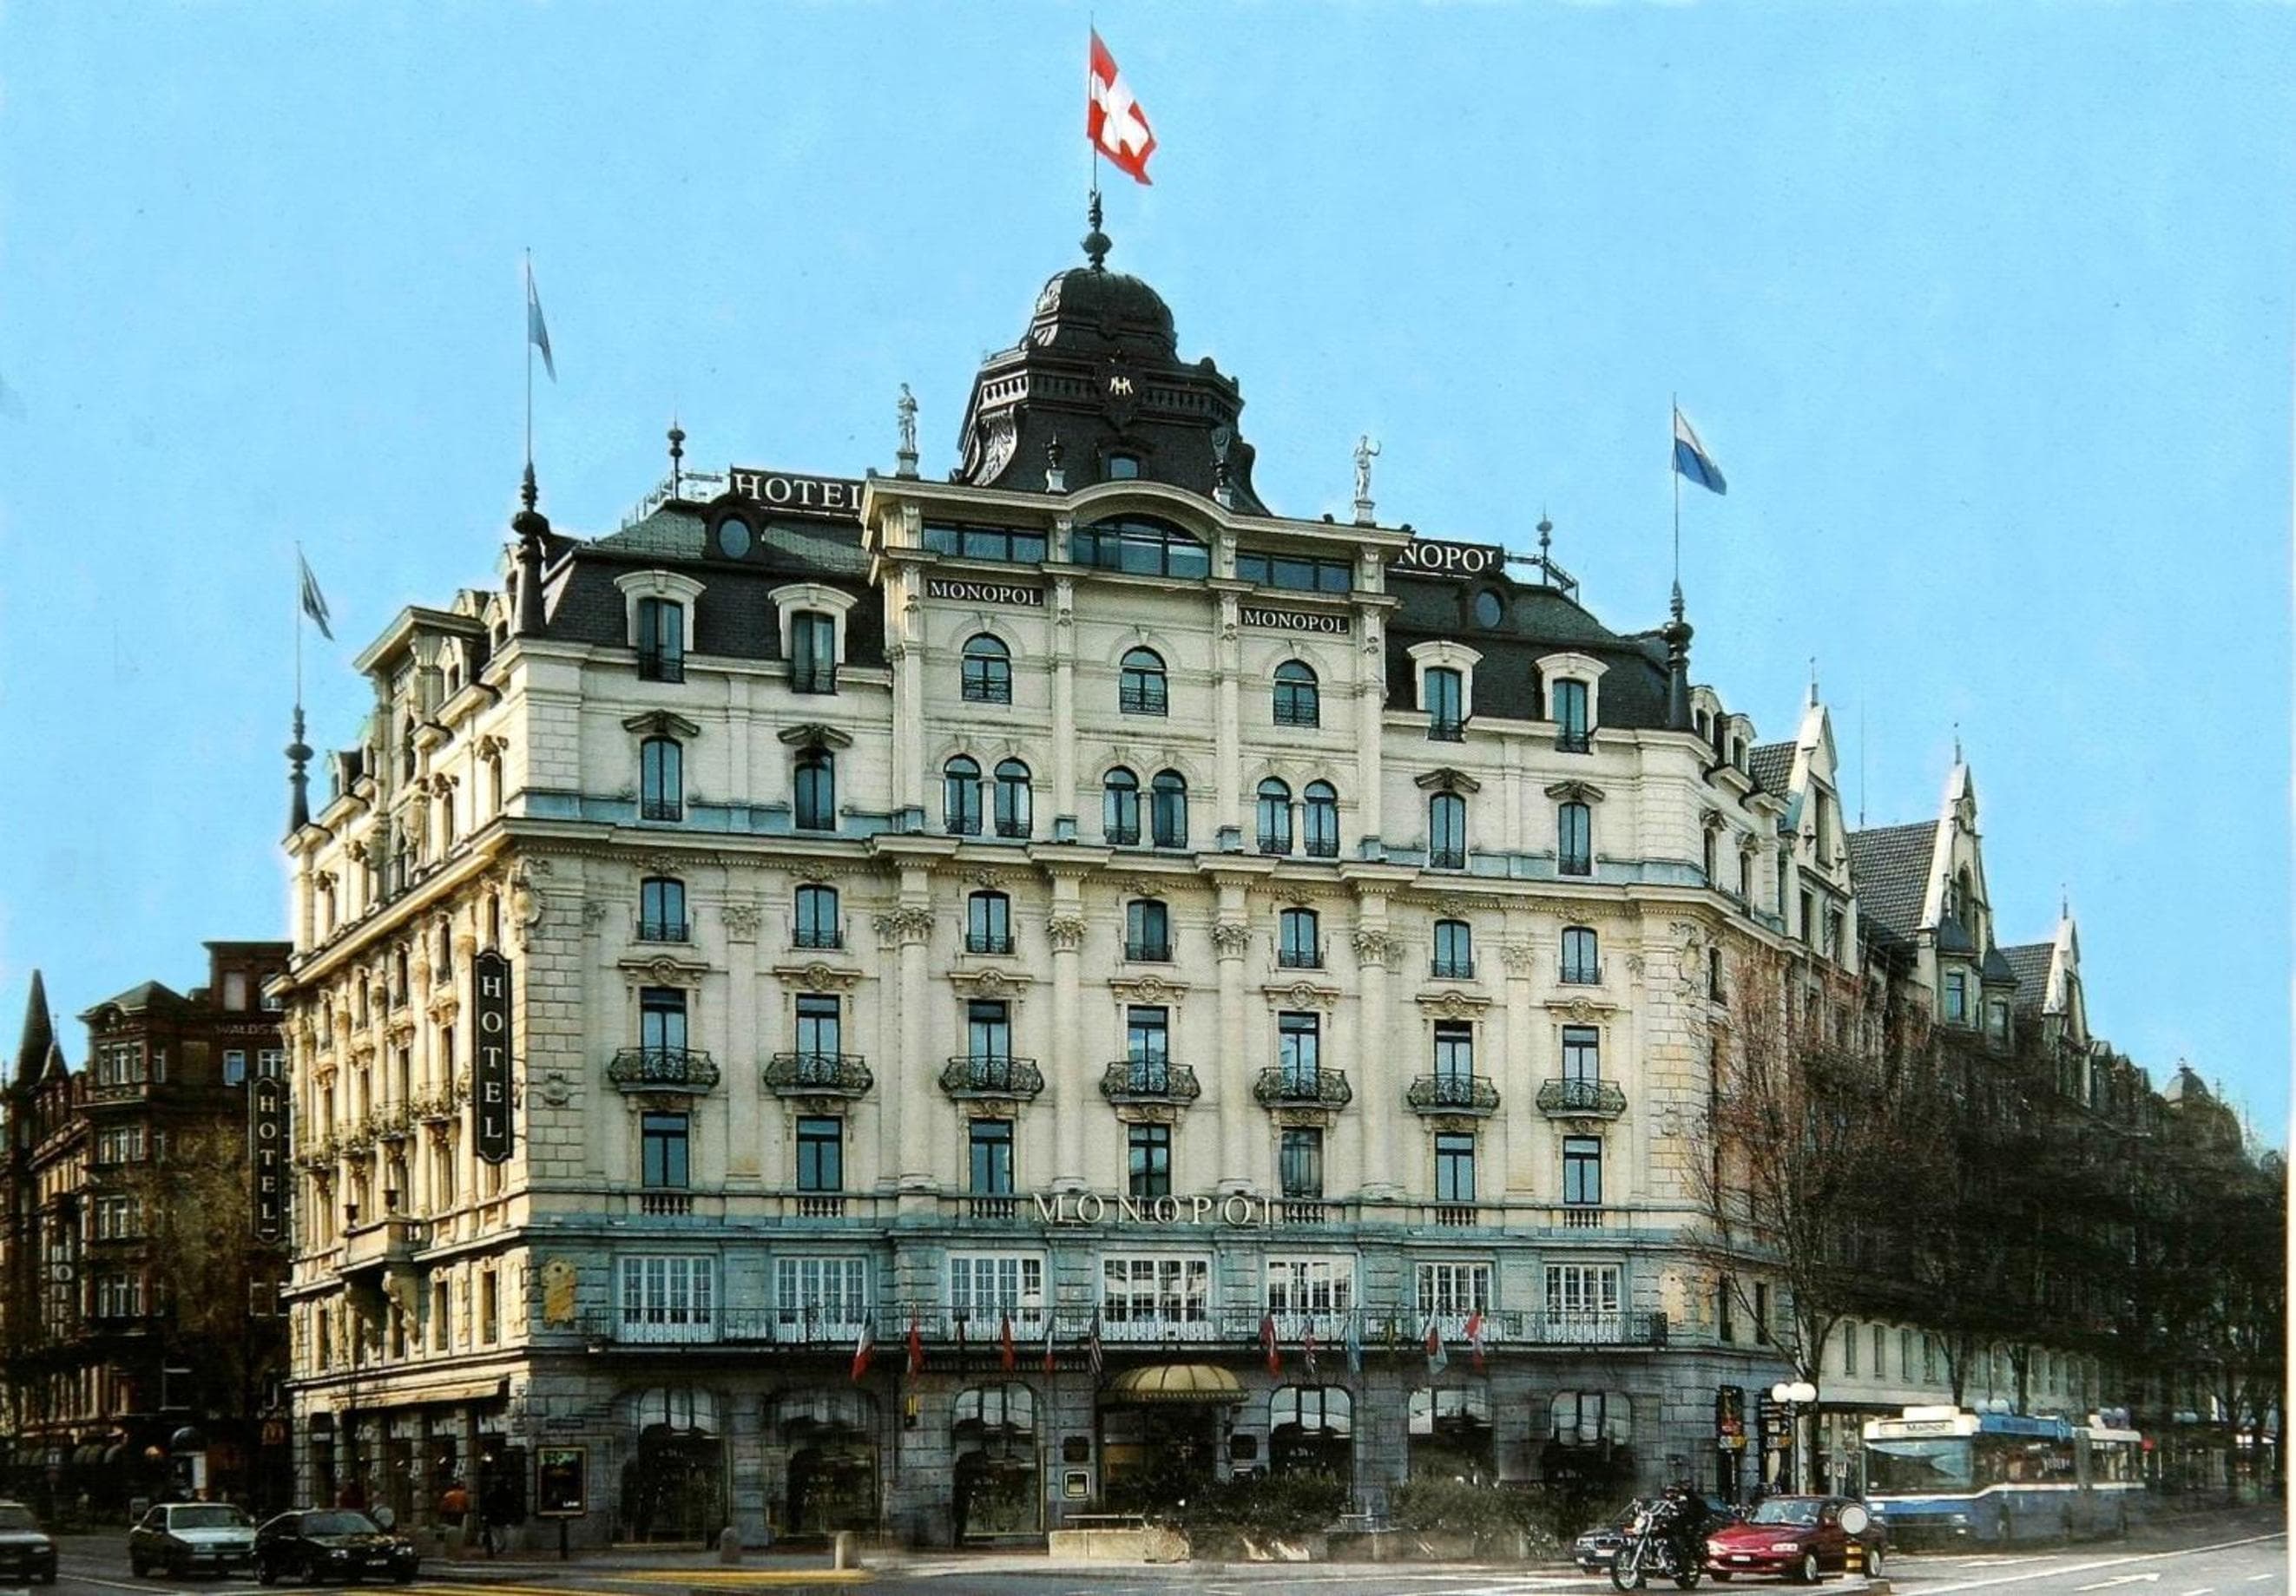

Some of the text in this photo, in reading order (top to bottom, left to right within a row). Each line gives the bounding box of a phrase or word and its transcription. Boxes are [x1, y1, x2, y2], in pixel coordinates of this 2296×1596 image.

[931, 581, 1041, 605] MONOPOL
[1244, 610, 1347, 633] MONOPOL
[482, 975, 503, 1139] HOTEL
[259, 1096, 276, 1219] HOTEL
